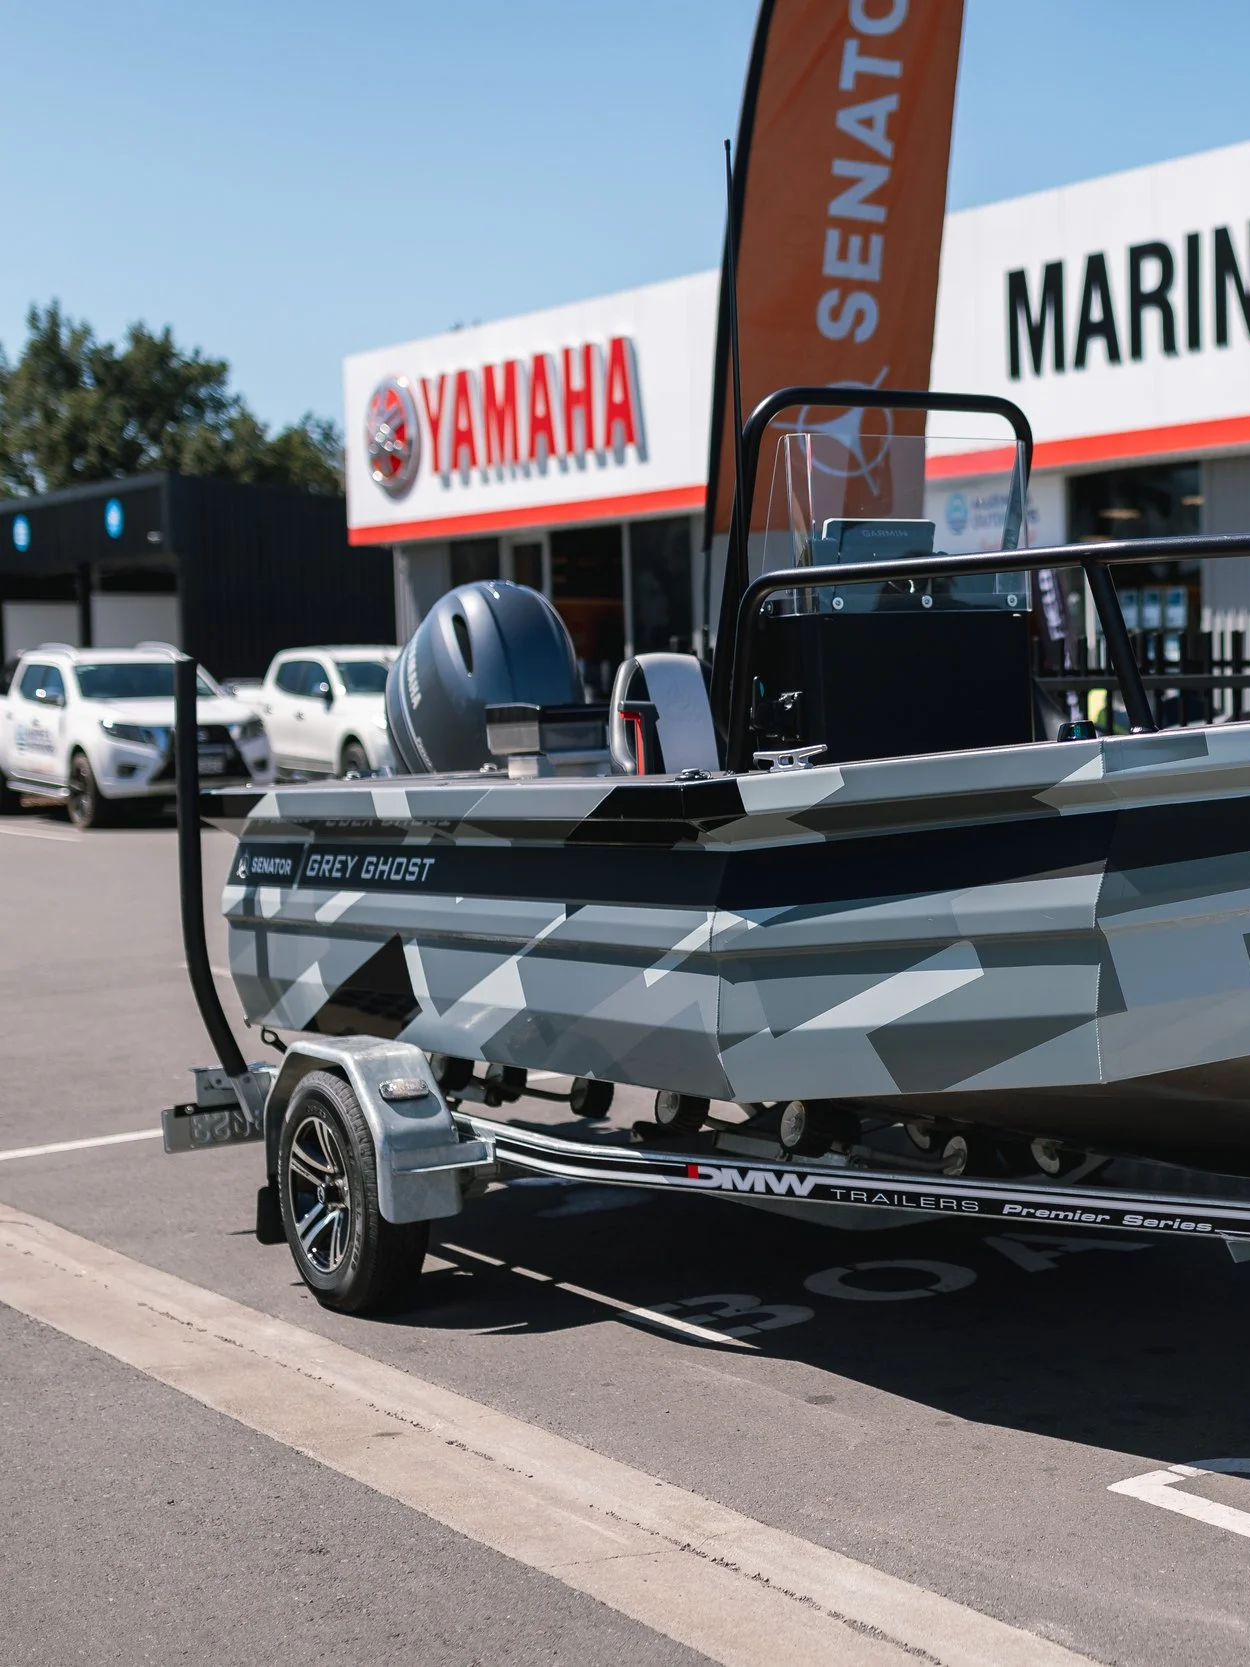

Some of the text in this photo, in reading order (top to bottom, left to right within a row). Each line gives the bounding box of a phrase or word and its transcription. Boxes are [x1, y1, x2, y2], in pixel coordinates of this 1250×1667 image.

[420, 336, 637, 474] YAMAHA
[862, 529, 908, 537] GARMIN
[251, 854, 435, 881] SENATOR GREY GHOST
[830, 1189, 979, 1212] TRAILERS
[1003, 1204, 1110, 1226] Premier
[1123, 1214, 1212, 1233] Series
